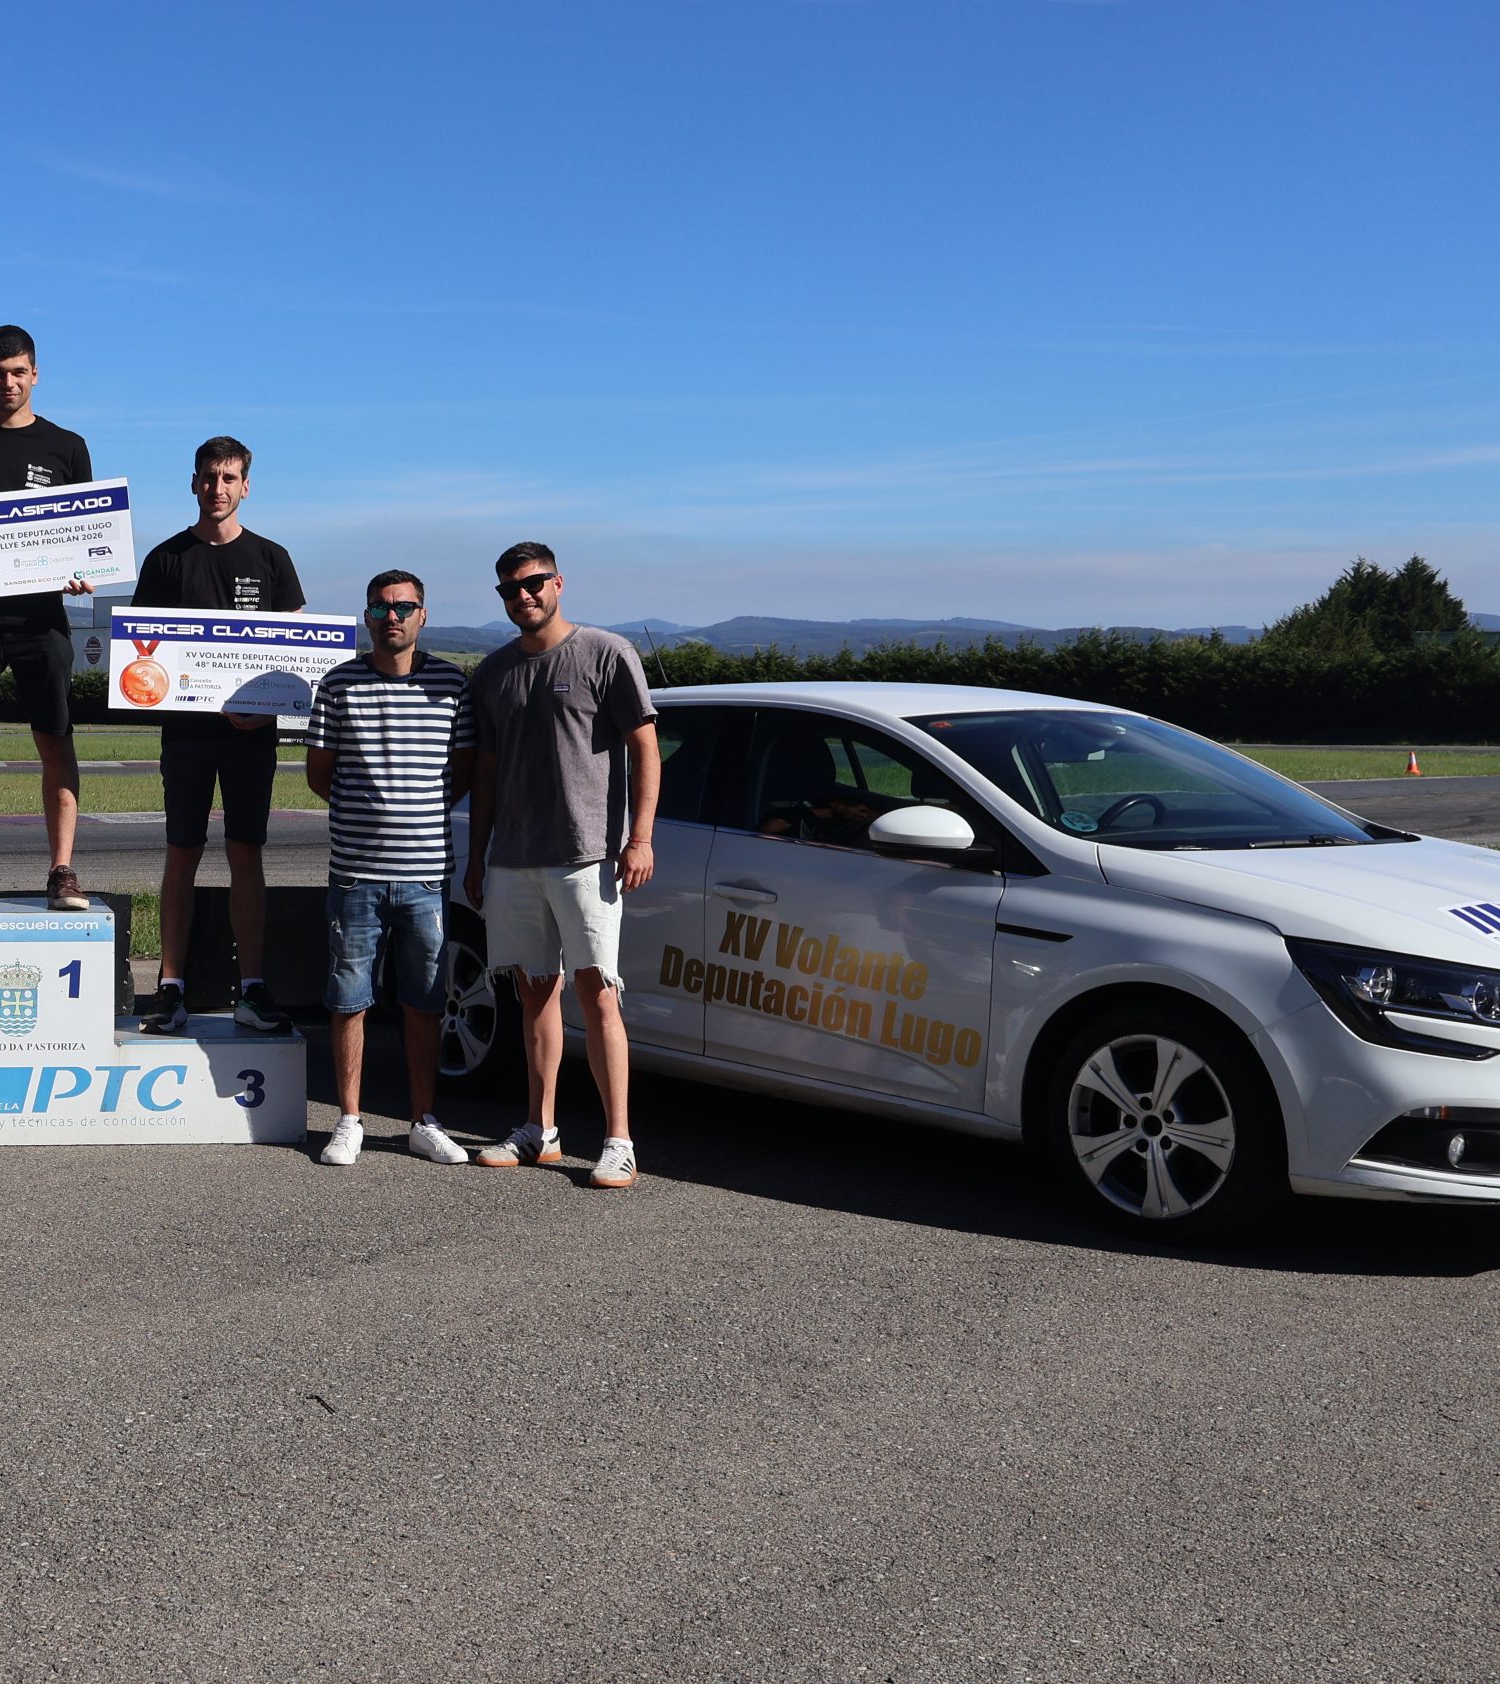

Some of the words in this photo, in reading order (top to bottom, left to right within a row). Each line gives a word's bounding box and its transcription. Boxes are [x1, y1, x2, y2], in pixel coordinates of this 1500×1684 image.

[17, 526, 73, 539] DEPUTACIÓN
[75, 525, 85, 534] DE
[87, 521, 112, 532] LUGO
[21, 538, 40, 547] SAN
[42, 534, 80, 545] FROILÁN
[82, 532, 103, 541] 2026
[85, 566, 120, 576] GÁNDARA
[4, 578, 37, 586] SANDERO
[122, 622, 204, 636] TERCER
[212, 625, 345, 642] CLASIFICADO
[185, 651, 197, 659] XV
[199, 652, 240, 661] VOLANTE
[242, 653, 298, 663] DEPUTACIÓN
[299, 656, 311, 664] DE
[312, 657, 337, 665] LUGO
[212, 661, 243, 670] RALLYE
[244, 663, 263, 671] SAN
[265, 662, 303, 673] FROILÁN
[305, 666, 327, 674] 2026
[719, 910, 772, 962] XV
[775, 922, 929, 1001] Volante
[58, 959, 82, 999] 1
[659, 944, 873, 1040] Deputación
[879, 1000, 982, 1068] Lugo
[9, 1043, 24, 1051] DA
[26, 1042, 86, 1051] PASTORIZA
[32, 1064, 188, 1114] PTC
[234, 1068, 266, 1109] 3
[0, 1118, 6, 1130] y
[11, 1115, 75, 1128] técnicas
[80, 1116, 97, 1127] de
[103, 1115, 187, 1127] conducción
